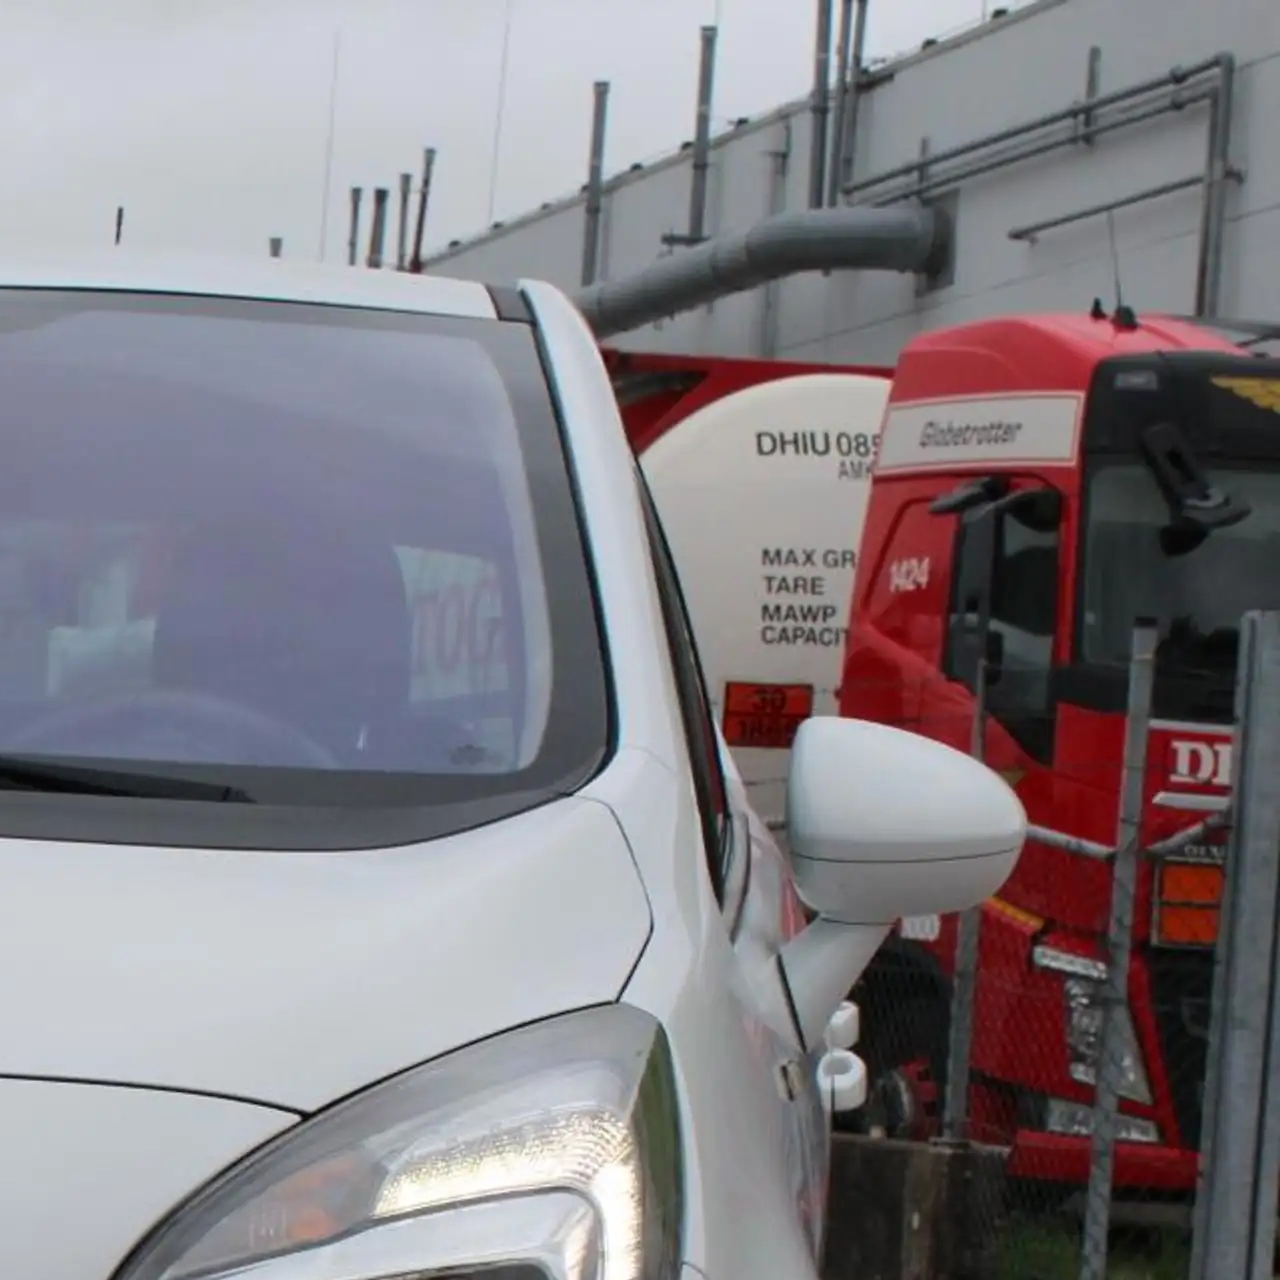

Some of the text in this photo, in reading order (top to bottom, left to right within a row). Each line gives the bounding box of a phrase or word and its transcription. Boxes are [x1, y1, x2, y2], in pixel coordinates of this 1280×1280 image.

[755, 432, 830, 456] DHIU
[761, 548, 816, 567] MAX
[890, 558, 930, 593] 1424
[765, 576, 825, 595] TARE
[761, 604, 836, 623] MAWP
